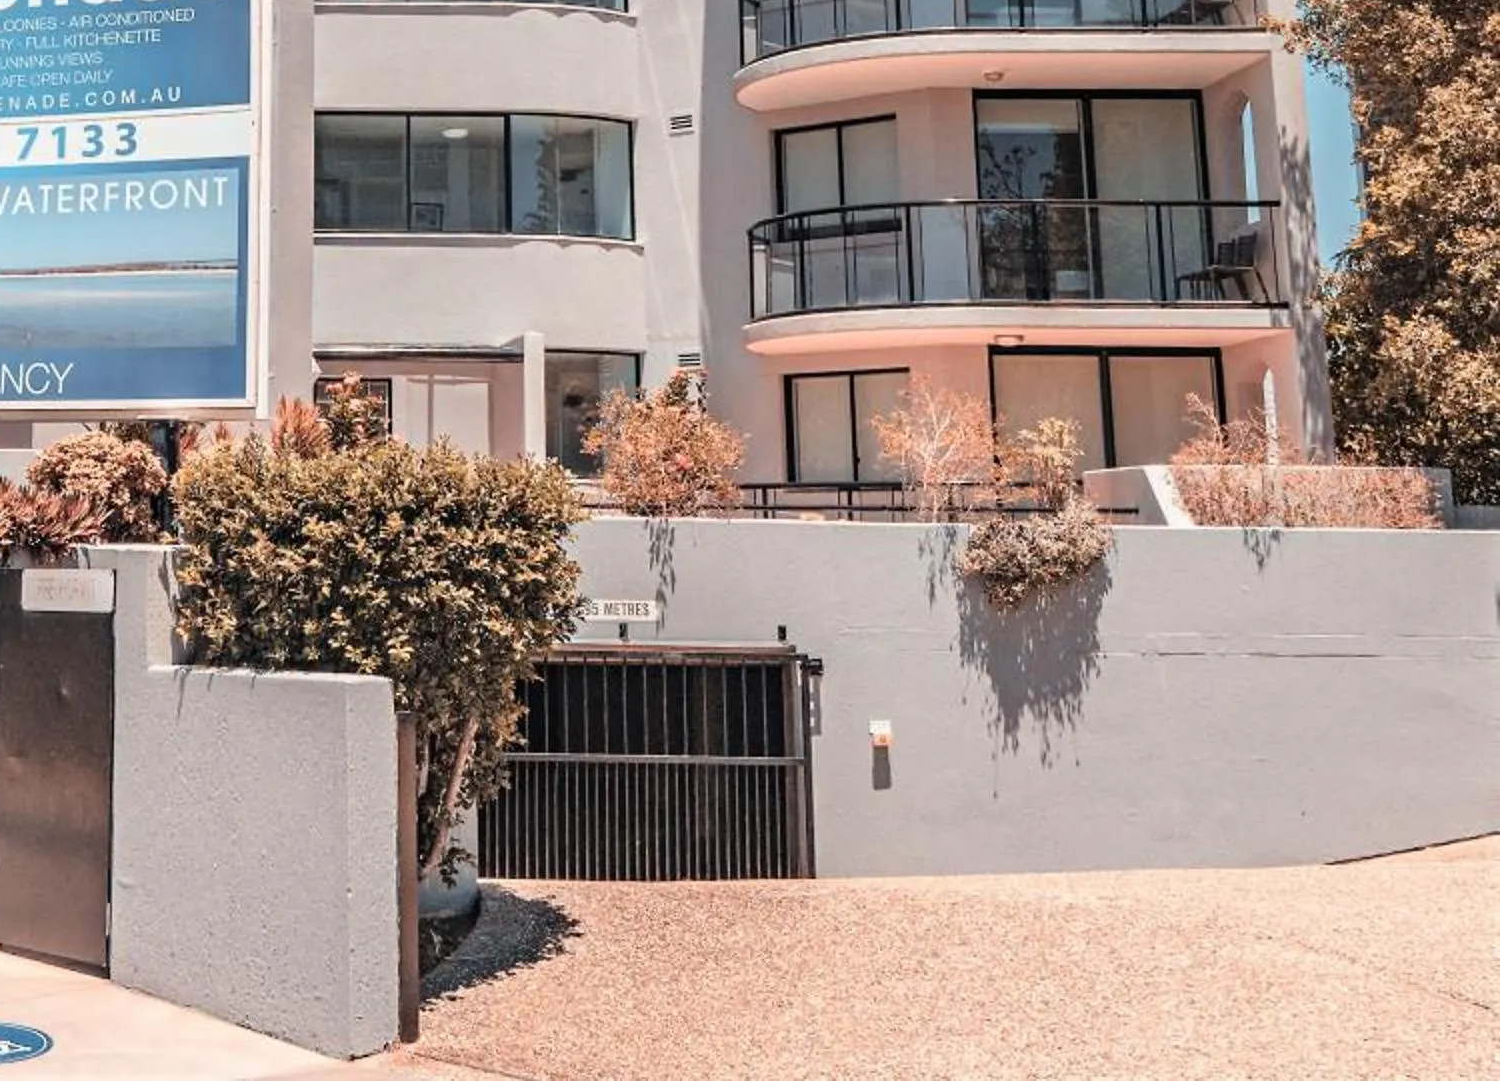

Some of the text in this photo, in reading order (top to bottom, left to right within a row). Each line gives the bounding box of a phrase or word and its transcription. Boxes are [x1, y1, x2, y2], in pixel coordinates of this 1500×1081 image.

[68, 15, 92, 28] AIR
[95, 8, 195, 27] CONDITIONED
[25, 35, 60, 50] FULL
[63, 29, 161, 47] KITCHENETTE
[57, 51, 104, 67] VIEWS
[31, 72, 70, 86] OPEN
[73, 69, 113, 84] DAILY
[16, 122, 138, 161] 7133
[604, 603, 649, 616] METRES
